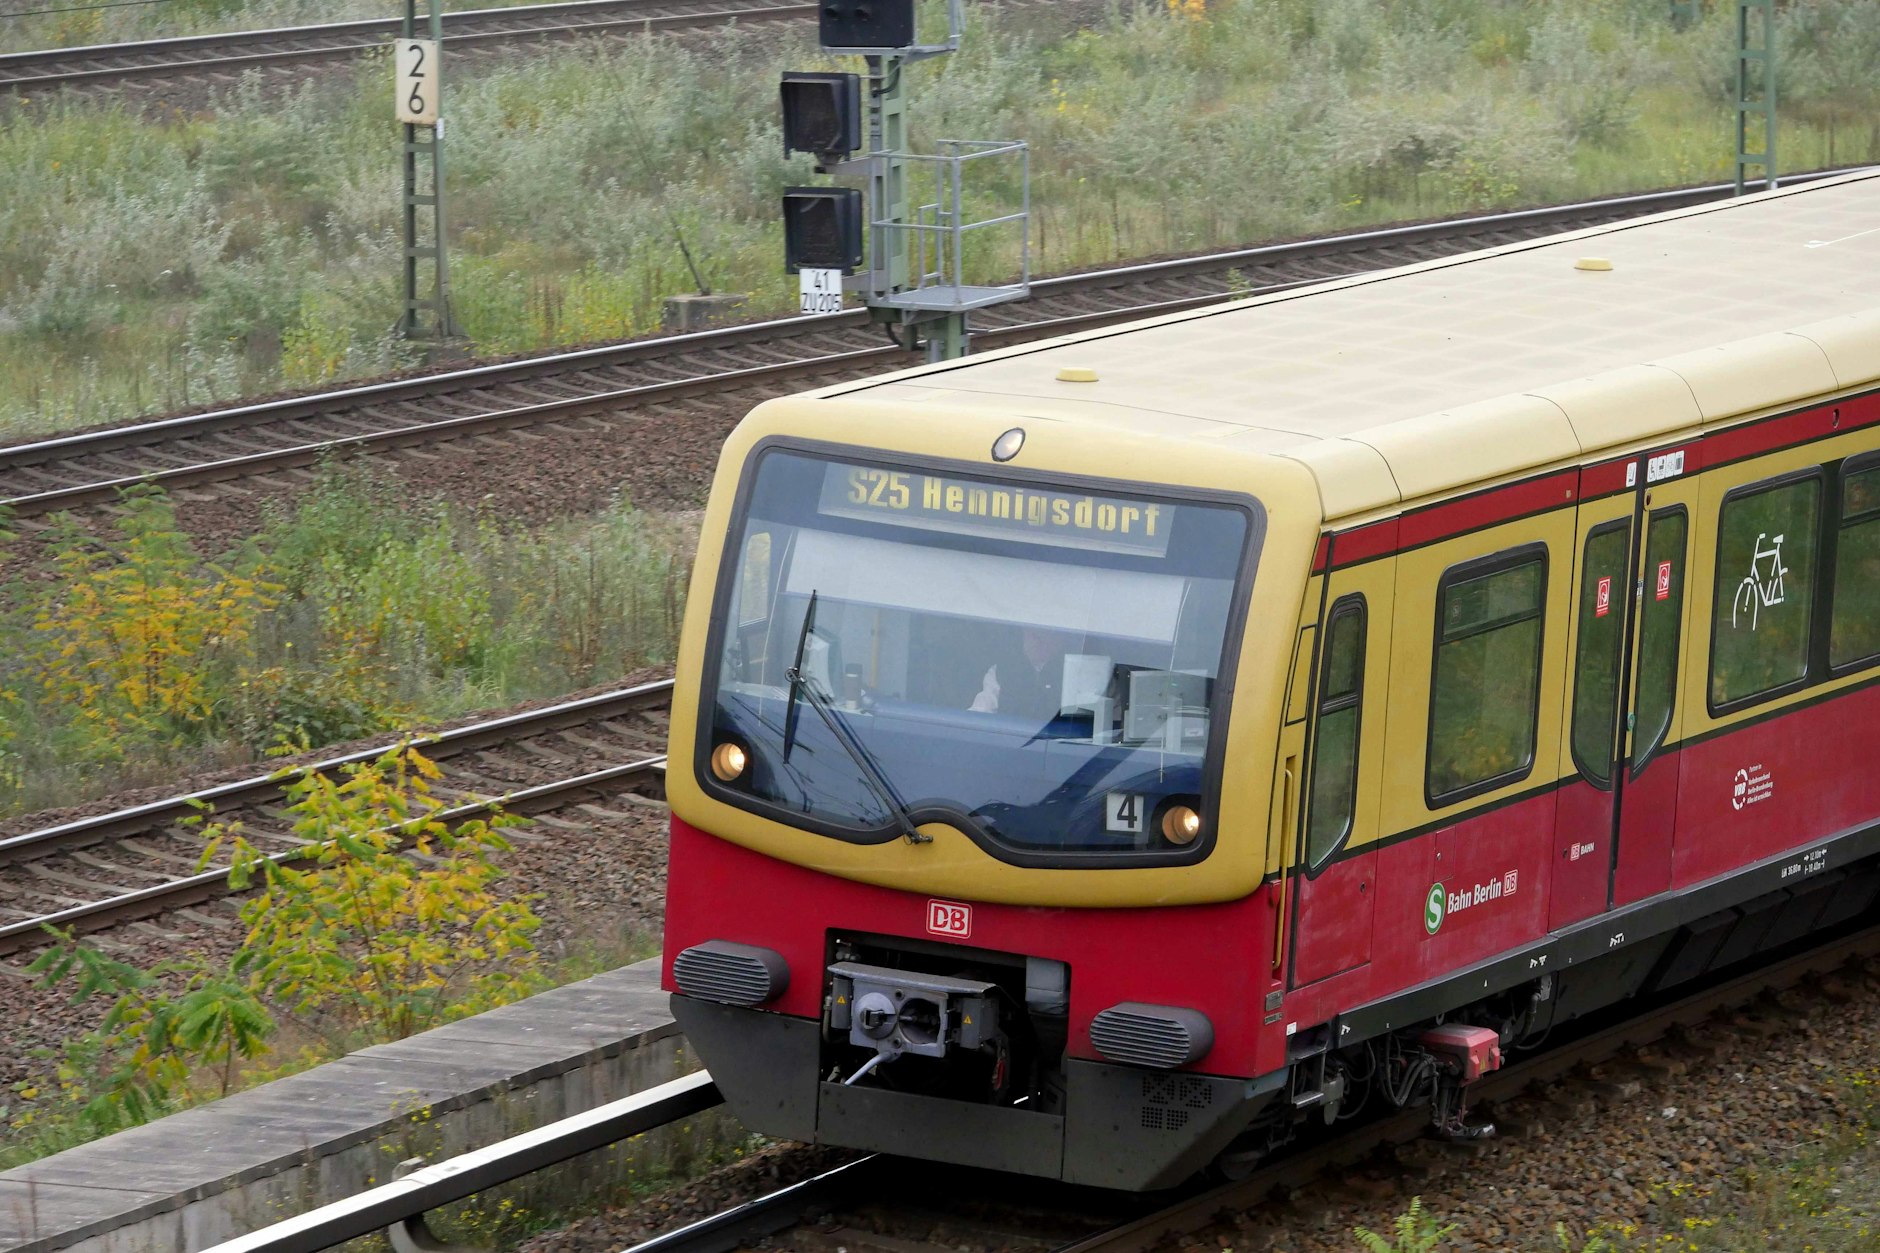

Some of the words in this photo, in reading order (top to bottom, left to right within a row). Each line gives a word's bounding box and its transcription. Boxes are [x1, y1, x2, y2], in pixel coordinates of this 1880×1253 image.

[408, 44, 425, 77] 2
[408, 82, 425, 114] 6
[813, 270, 829, 291] 41
[801, 292, 842, 312] ZU205
[847, 468, 911, 510] S25
[922, 475, 1161, 537] Hennigsdorf
[1116, 792, 1138, 829] 4
[1581, 842, 1595, 855] BAHN
[1427, 888, 1443, 929] S
[1447, 889, 1472, 914] Bahn
[1473, 877, 1502, 906] Berlin
[1504, 873, 1517, 893] DB
[931, 904, 967, 933] DB
